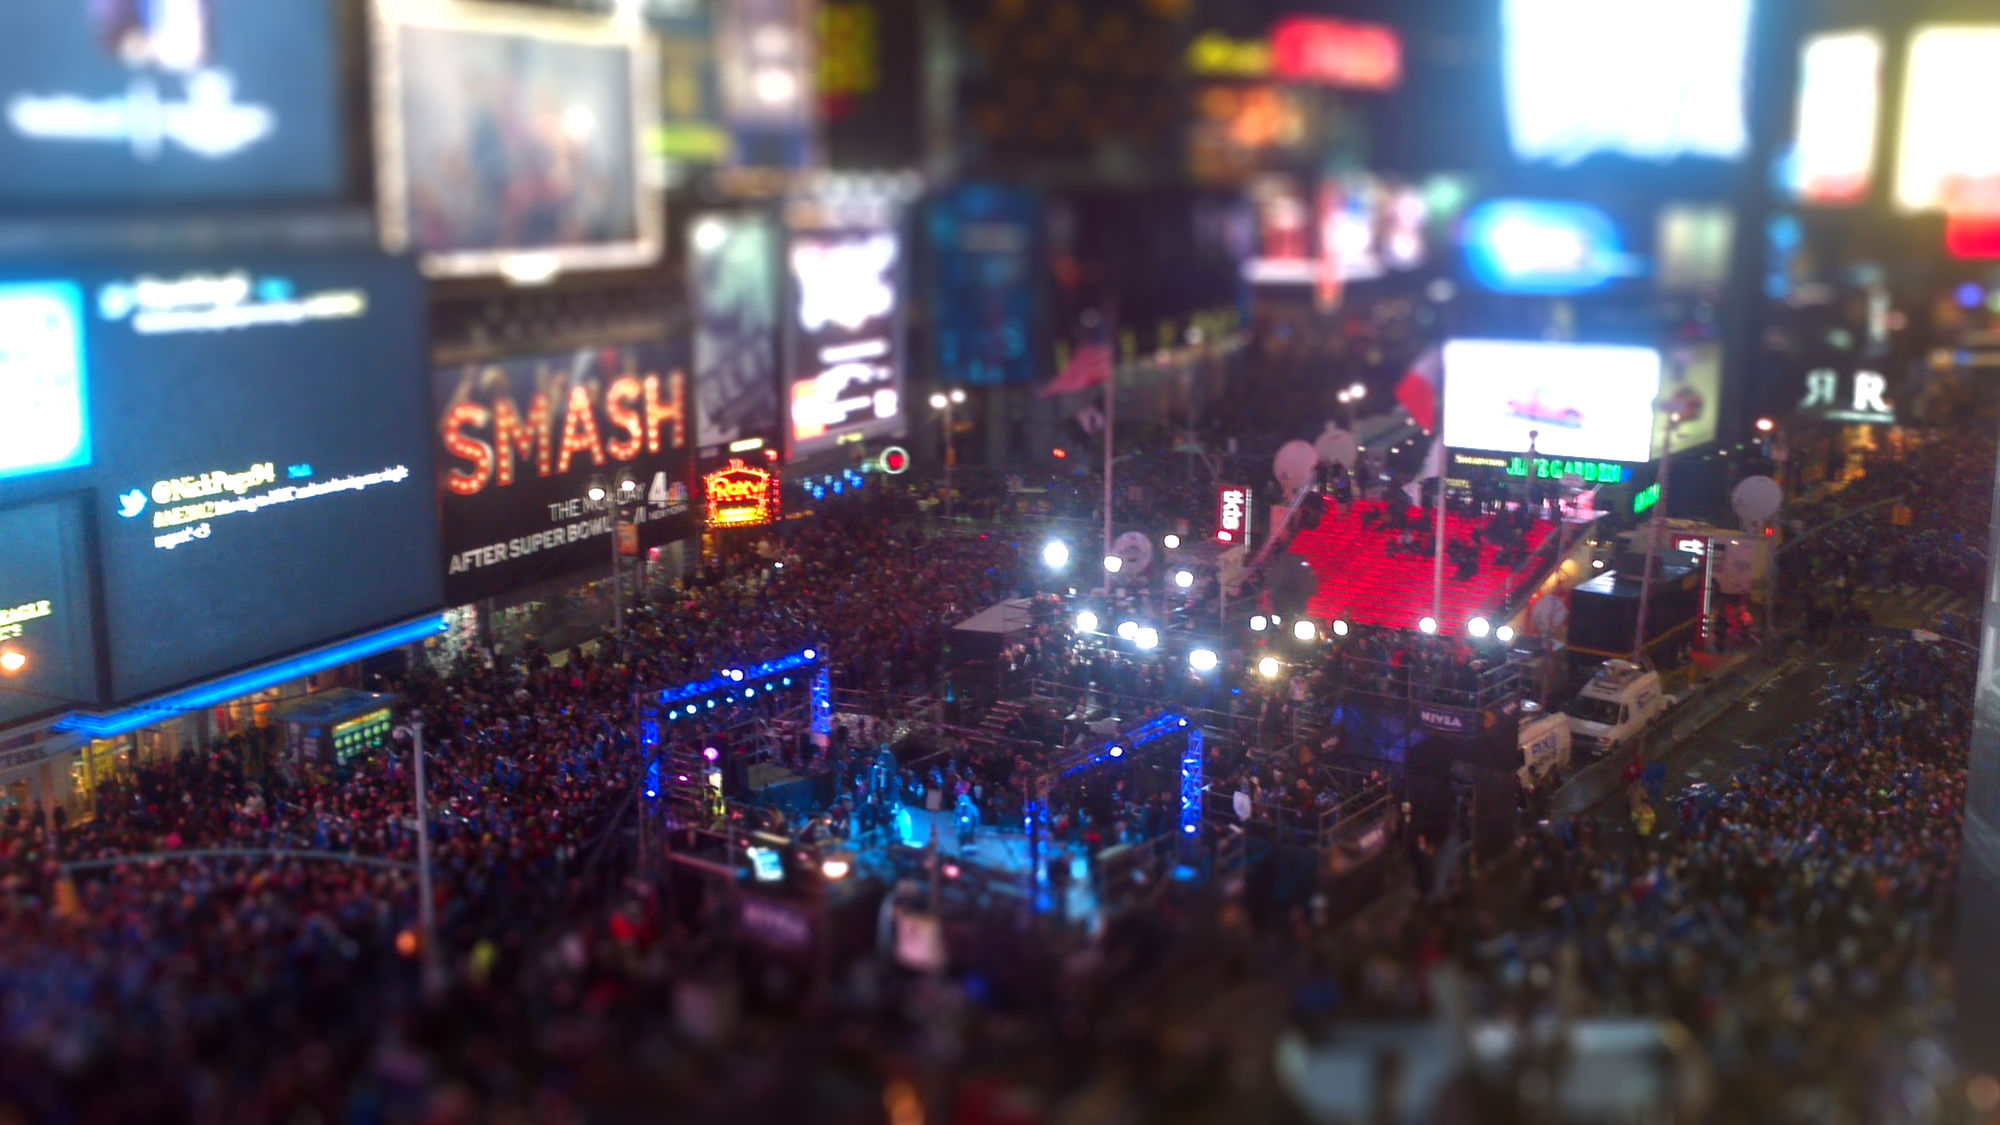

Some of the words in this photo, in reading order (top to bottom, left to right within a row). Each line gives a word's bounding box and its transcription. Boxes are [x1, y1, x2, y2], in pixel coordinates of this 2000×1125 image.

[1853, 370, 1889, 412] R
[441, 368, 689, 497] SMASH
[547, 498, 582, 522] THE
[582, 482, 646, 514] MODAY
[647, 471, 668, 509] 4
[1222, 489, 1245, 530] tkts
[449, 542, 508, 575] AFTER
[509, 526, 566, 559] SUPER
[567, 514, 614, 543] BOWL
[1420, 709, 1463, 728] NIVEA
